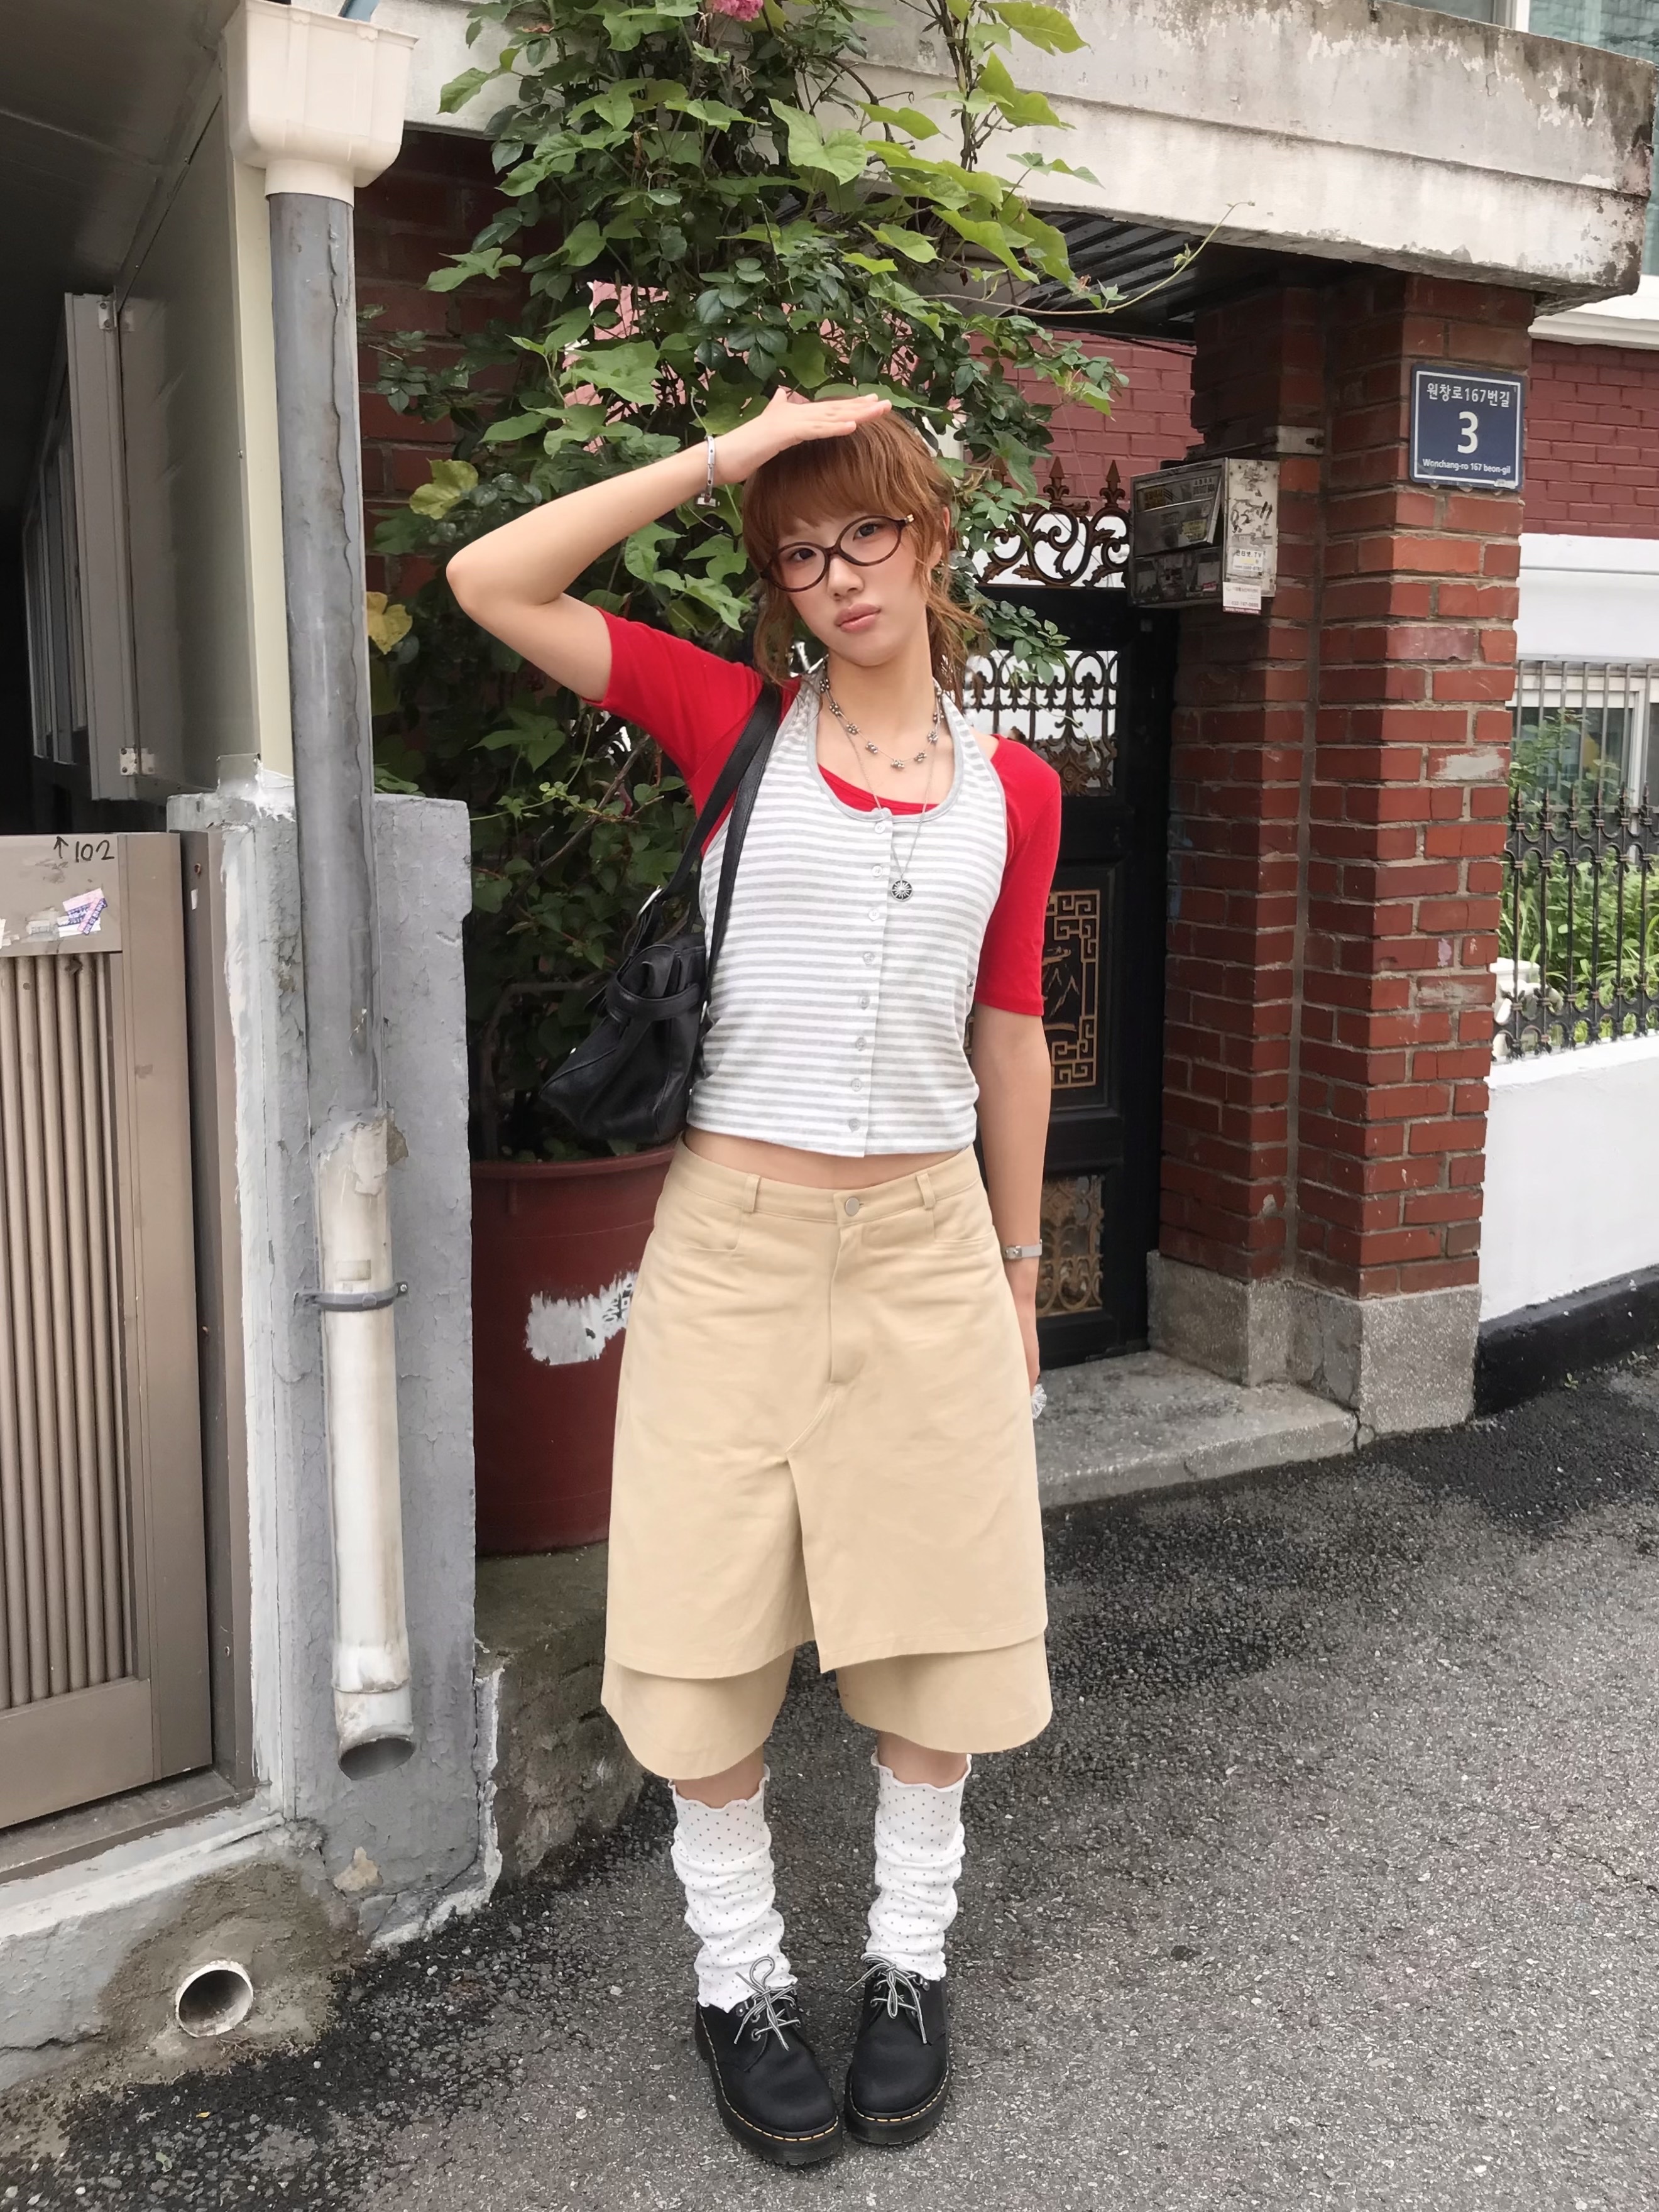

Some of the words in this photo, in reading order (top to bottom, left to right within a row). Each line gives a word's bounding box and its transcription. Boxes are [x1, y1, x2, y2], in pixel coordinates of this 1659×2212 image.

[1426, 383, 1509, 408] 원창로167번길
[1457, 411, 1479, 454] 3
[1422, 458, 1469, 471] Wonchang-ro
[1470, 463, 1482, 471] 167
[1483, 464, 1511, 476] beon-gil
[75, 840, 115, 863] 102
